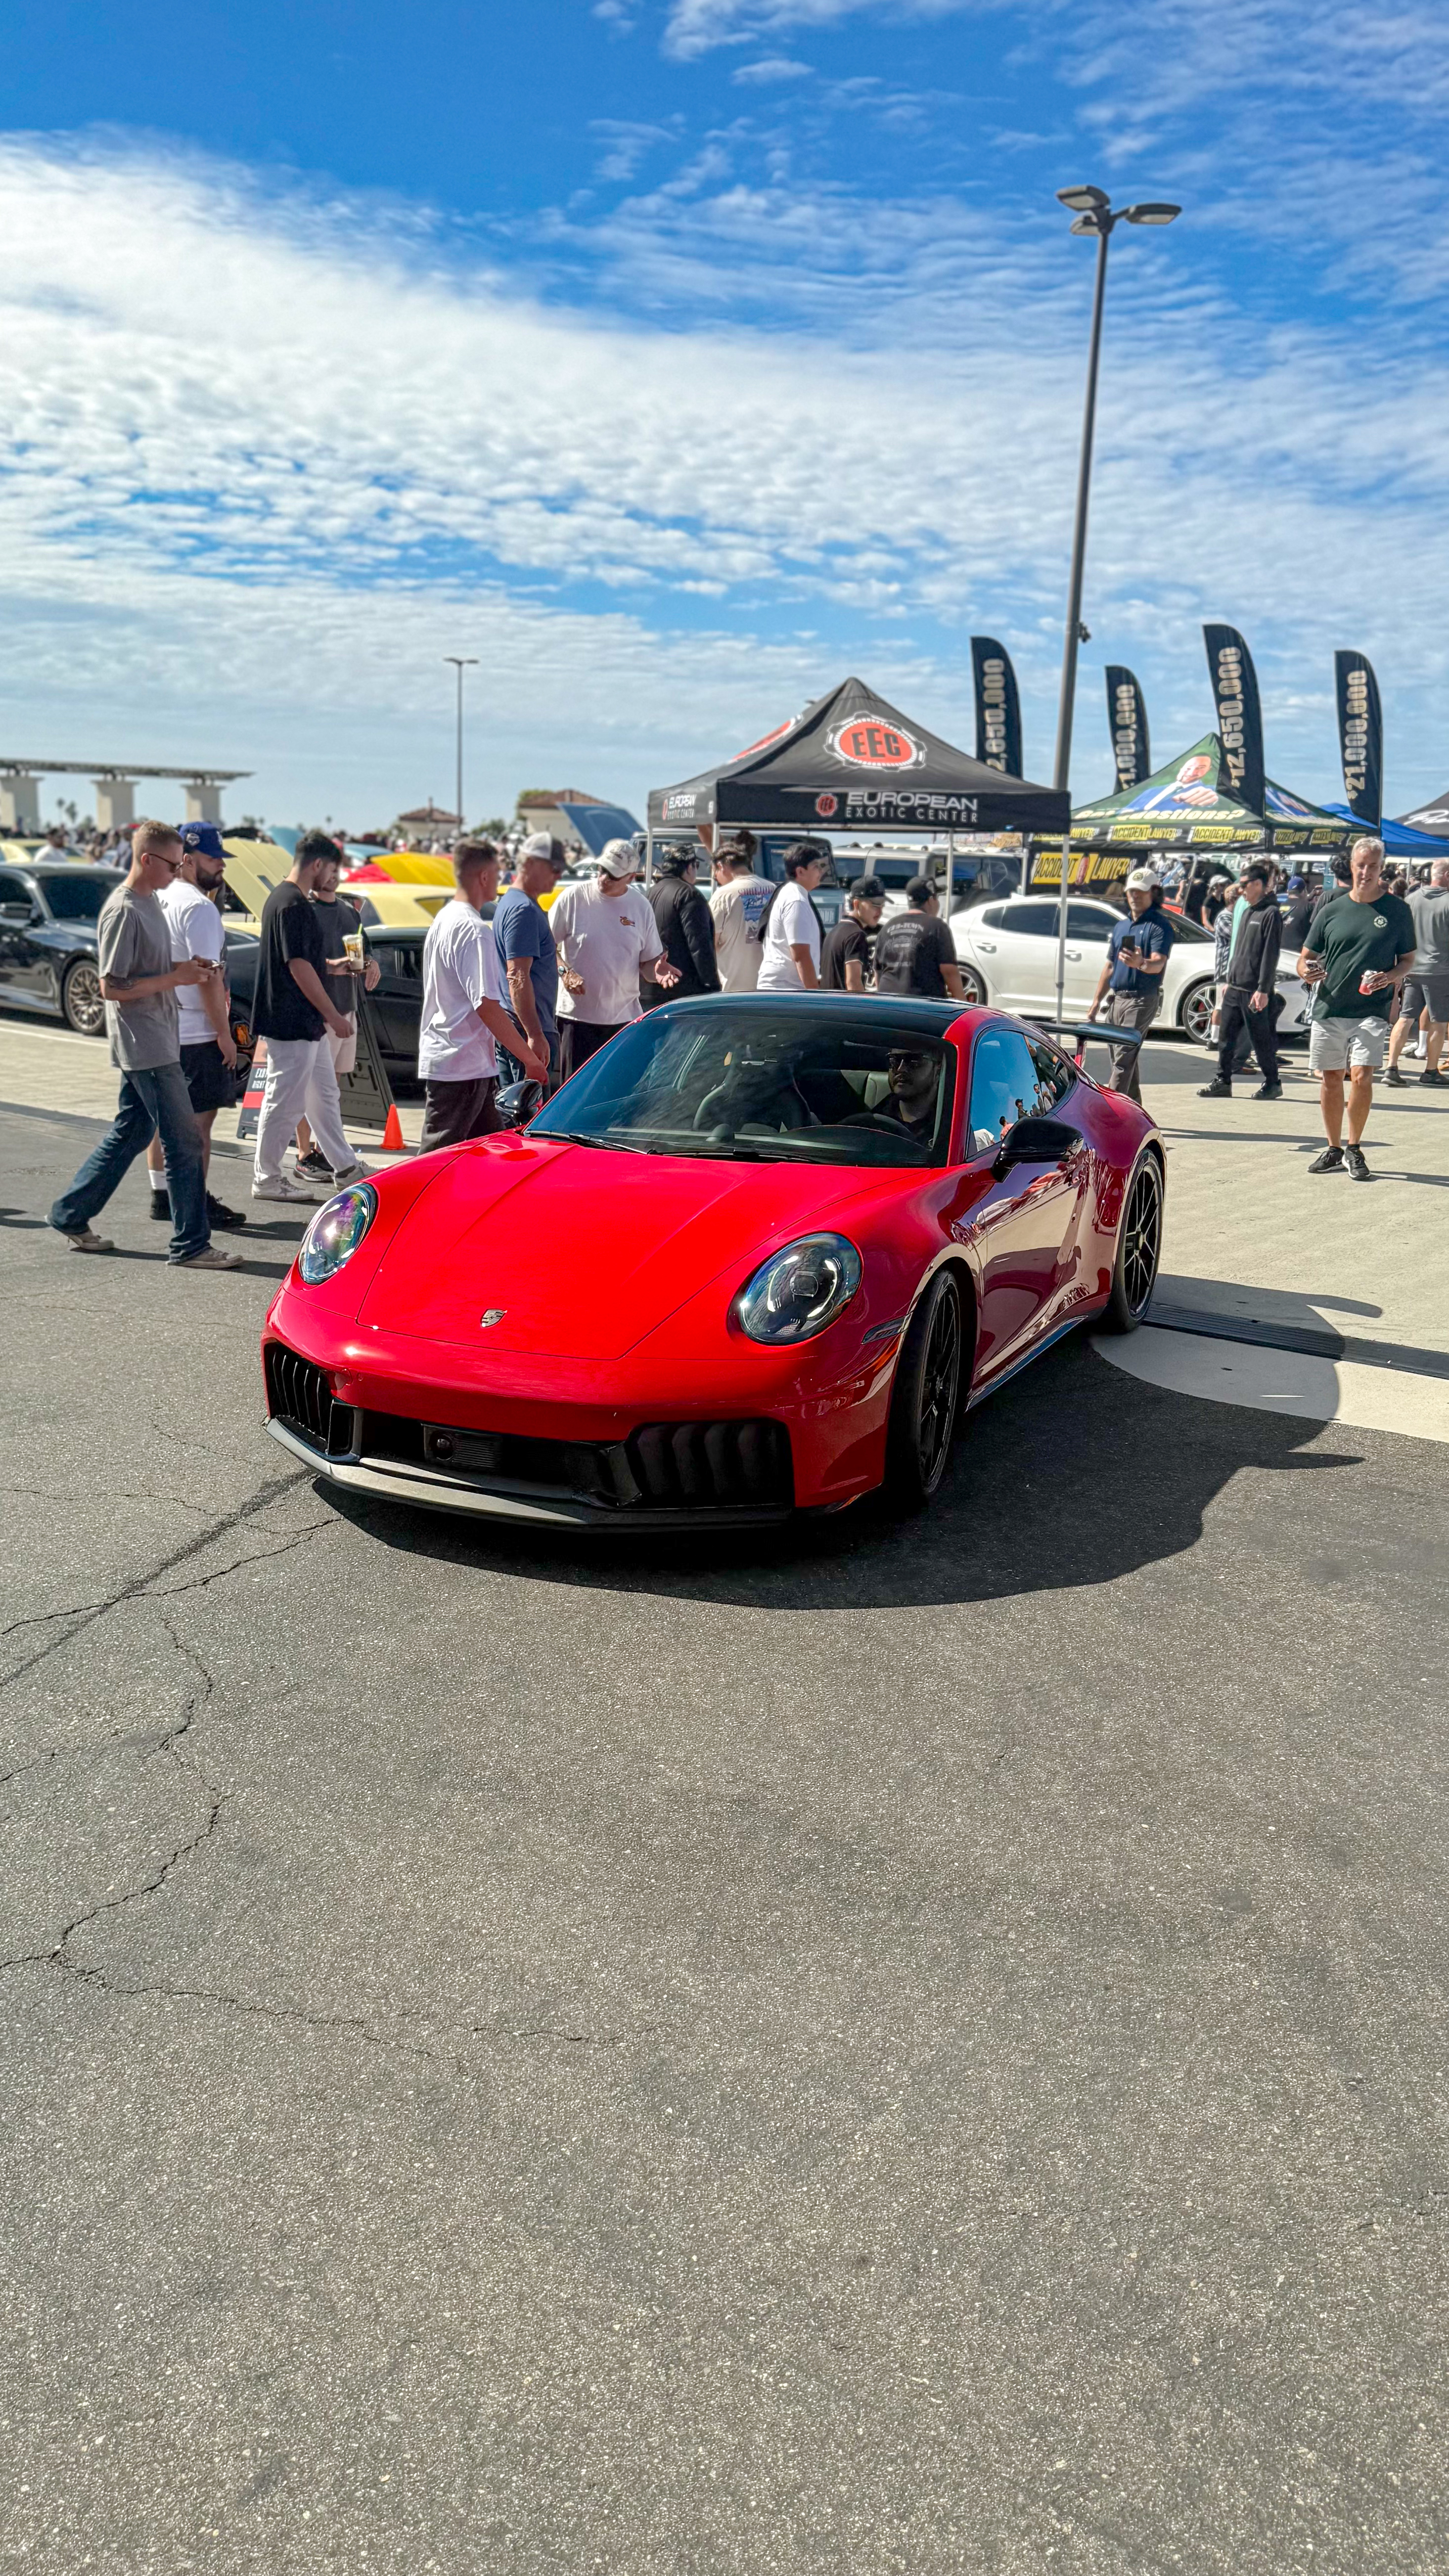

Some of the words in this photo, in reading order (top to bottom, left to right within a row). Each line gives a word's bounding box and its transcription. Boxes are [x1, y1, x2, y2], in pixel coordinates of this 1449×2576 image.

[851, 727, 901, 758] EEC
[847, 792, 977, 811] EUROPEAN
[846, 807, 906, 818] EXOTIC
[916, 809, 977, 823] CENTER
[1069, 828, 1096, 839] AWYER
